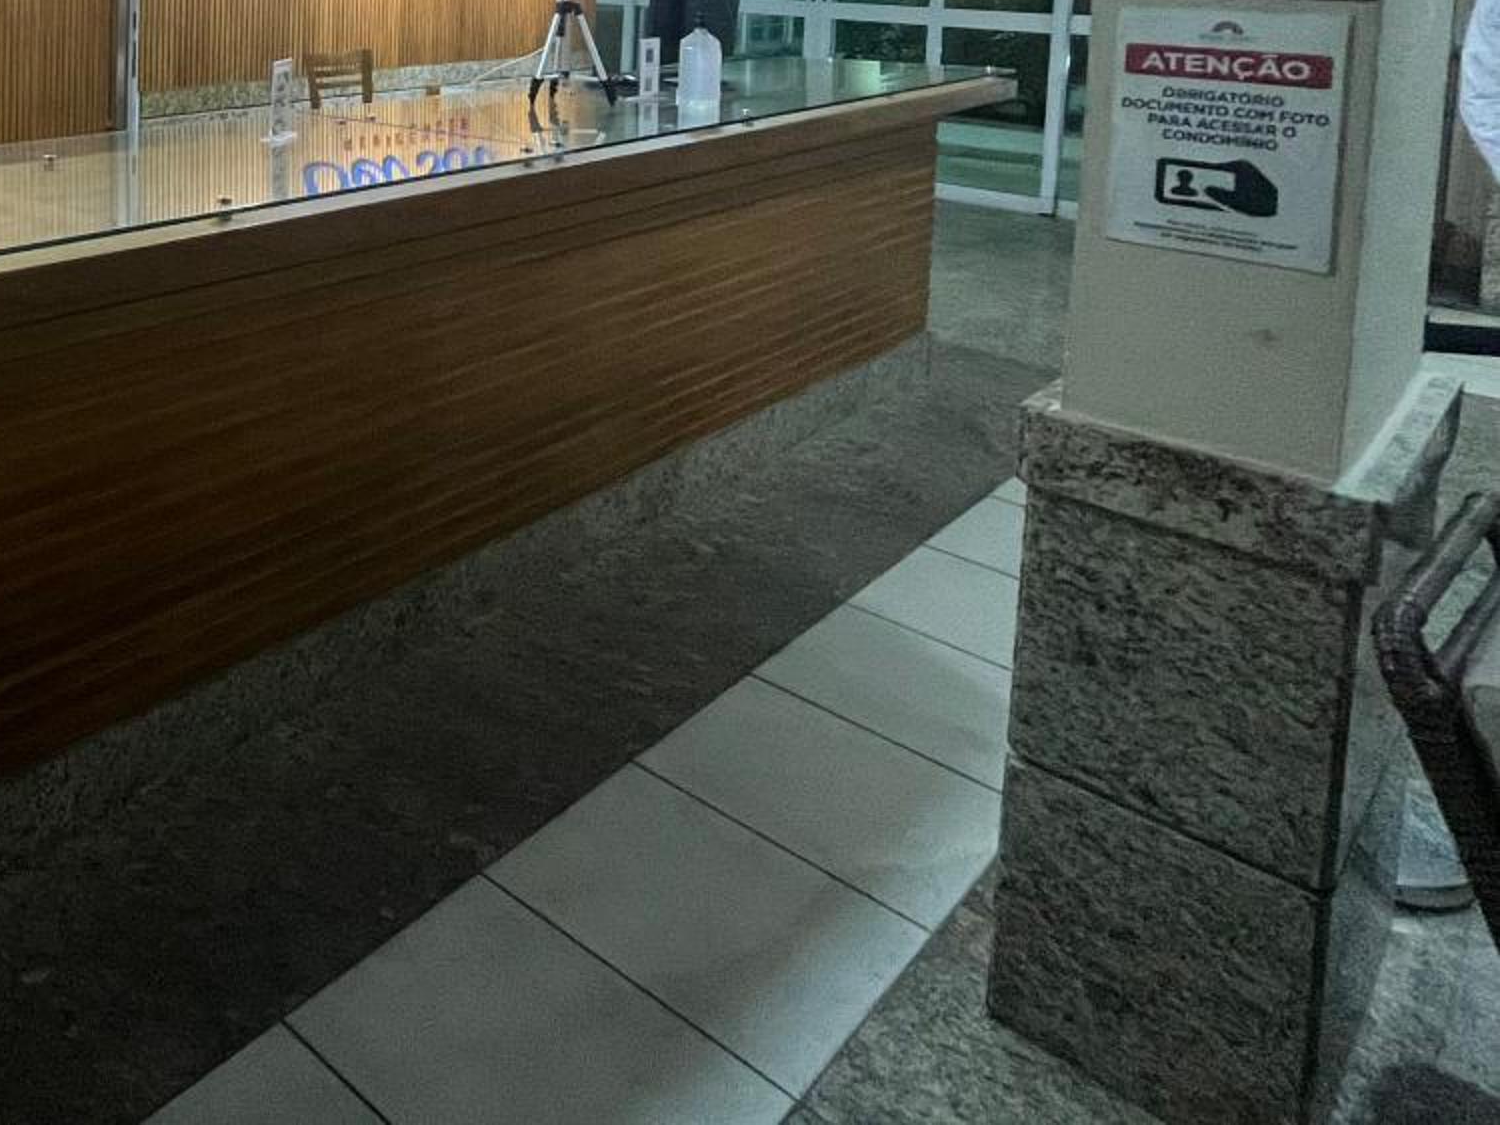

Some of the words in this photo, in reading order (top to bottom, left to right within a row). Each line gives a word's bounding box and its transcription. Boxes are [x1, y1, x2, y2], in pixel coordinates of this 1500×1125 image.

[1141, 51, 1312, 81] ATENÇÃO
[1121, 96, 1229, 118] DOCUMENTO
[1233, 106, 1275, 122] COM
[1279, 111, 1331, 127] FOTO
[1147, 112, 1191, 128] PARA
[1196, 117, 1277, 137] ACESSAR
[1282, 125, 1297, 138] O
